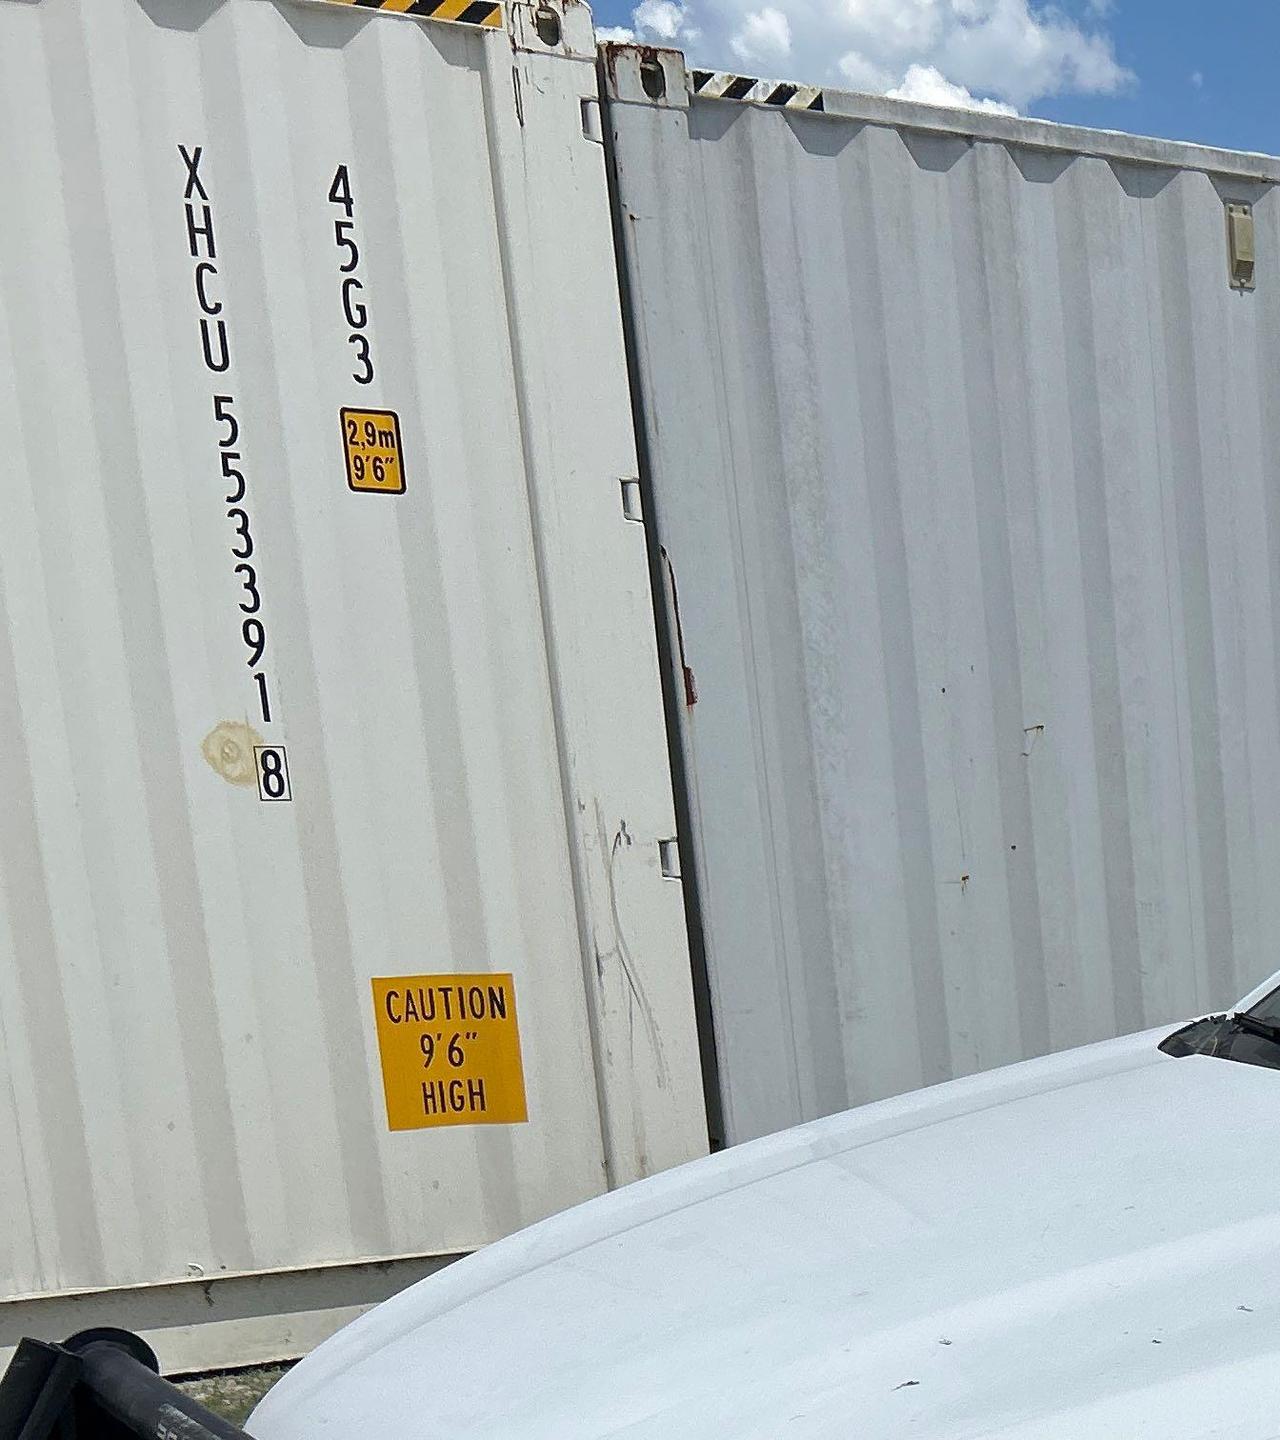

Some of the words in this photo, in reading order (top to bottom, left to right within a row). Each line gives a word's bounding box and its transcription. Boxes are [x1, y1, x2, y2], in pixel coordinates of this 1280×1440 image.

[328, 164, 374, 385] 45G3
[346, 419, 396, 451] 2,9m
[177, 145, 231, 373] XHCU
[213, 395, 272, 722] 553391
[260, 750, 287, 798] 8
[385, 985, 507, 1023] CAUTION
[423, 1079, 486, 1115] HIGH
